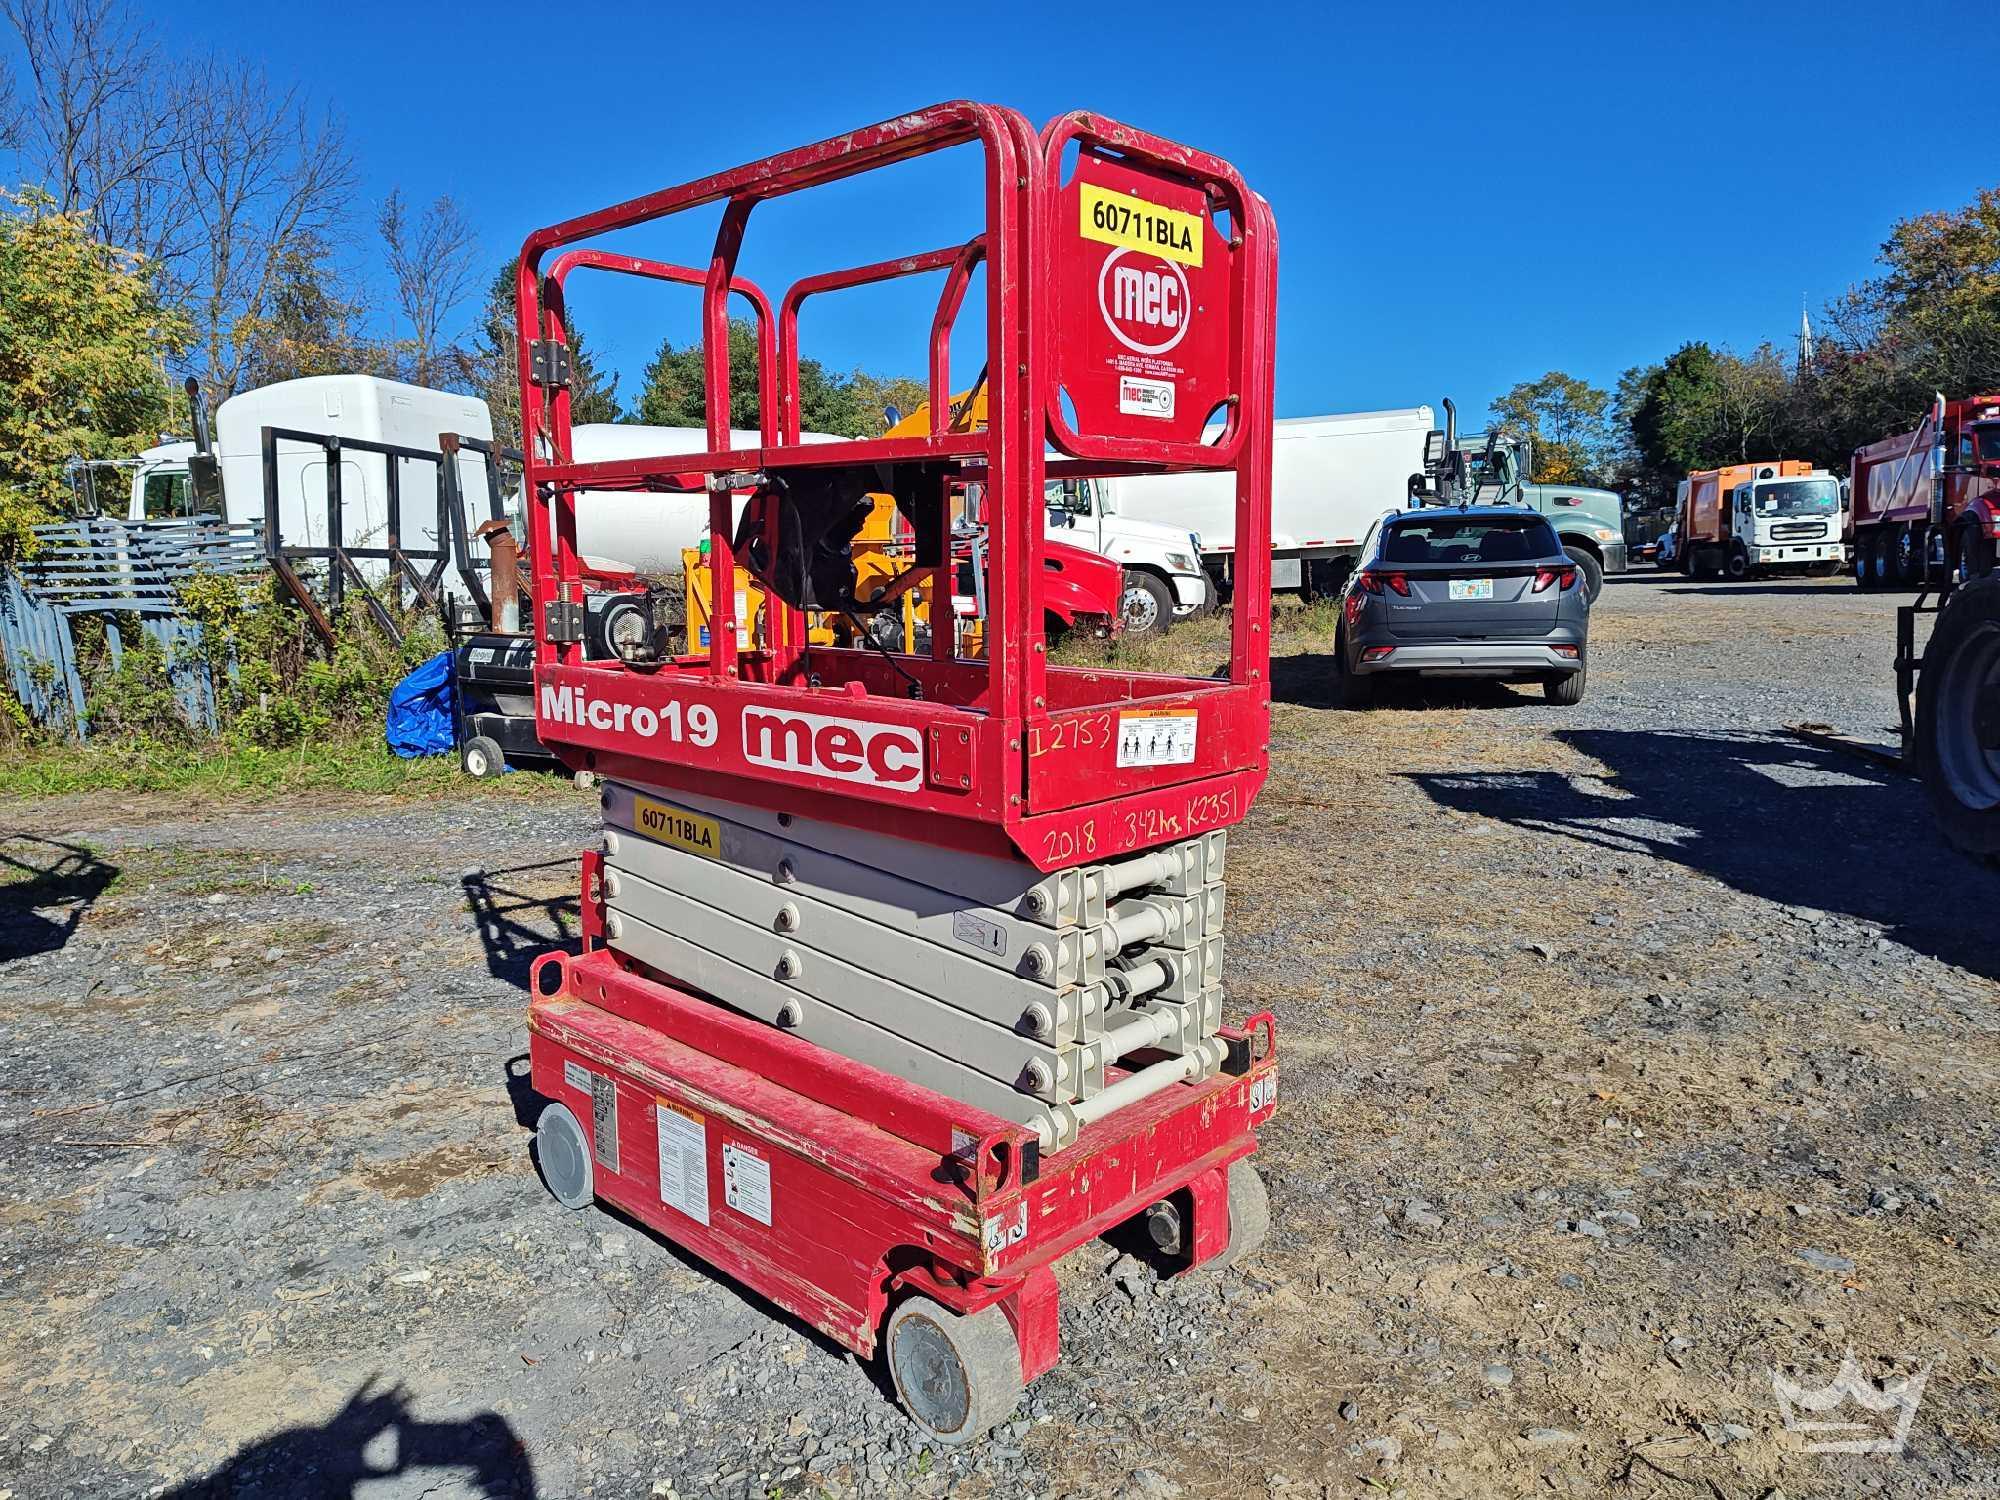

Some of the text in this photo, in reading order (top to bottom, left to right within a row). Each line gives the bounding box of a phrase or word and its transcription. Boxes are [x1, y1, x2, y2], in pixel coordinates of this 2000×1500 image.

[1094, 201, 1193, 252] 60711BLA
[1114, 266, 1178, 328] mec
[1123, 387, 1142, 401] mec
[541, 685, 718, 747] Micro19
[745, 710, 921, 783] mec
[642, 807, 713, 849] 60711BLA
[1042, 820, 1096, 863] 2018
[1187, 786, 1238, 832] K2351
[736, 1141, 759, 1157] DANGER
